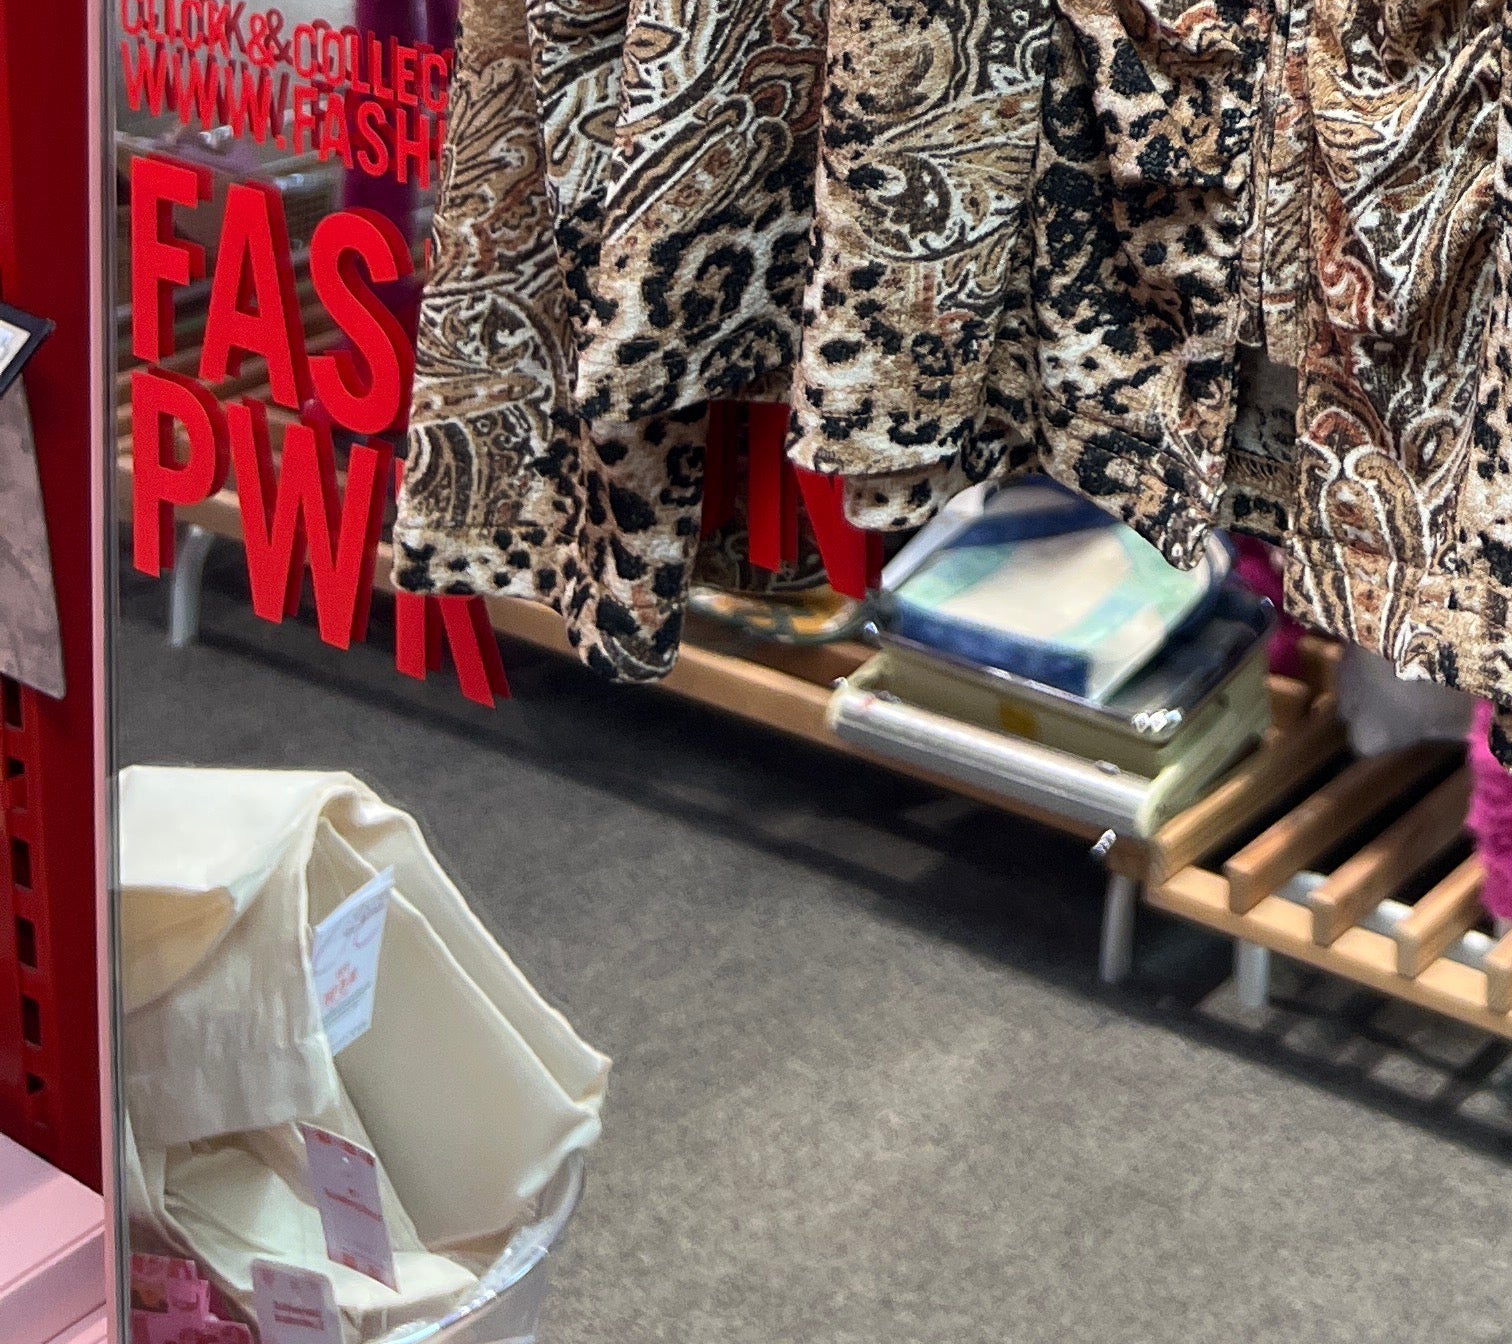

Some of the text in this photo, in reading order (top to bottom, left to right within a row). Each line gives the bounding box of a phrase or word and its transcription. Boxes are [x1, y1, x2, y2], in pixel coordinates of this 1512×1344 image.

[246, 12, 279, 68] &
[293, 23, 449, 113] COLLEC
[131, 156, 416, 434] FAS
